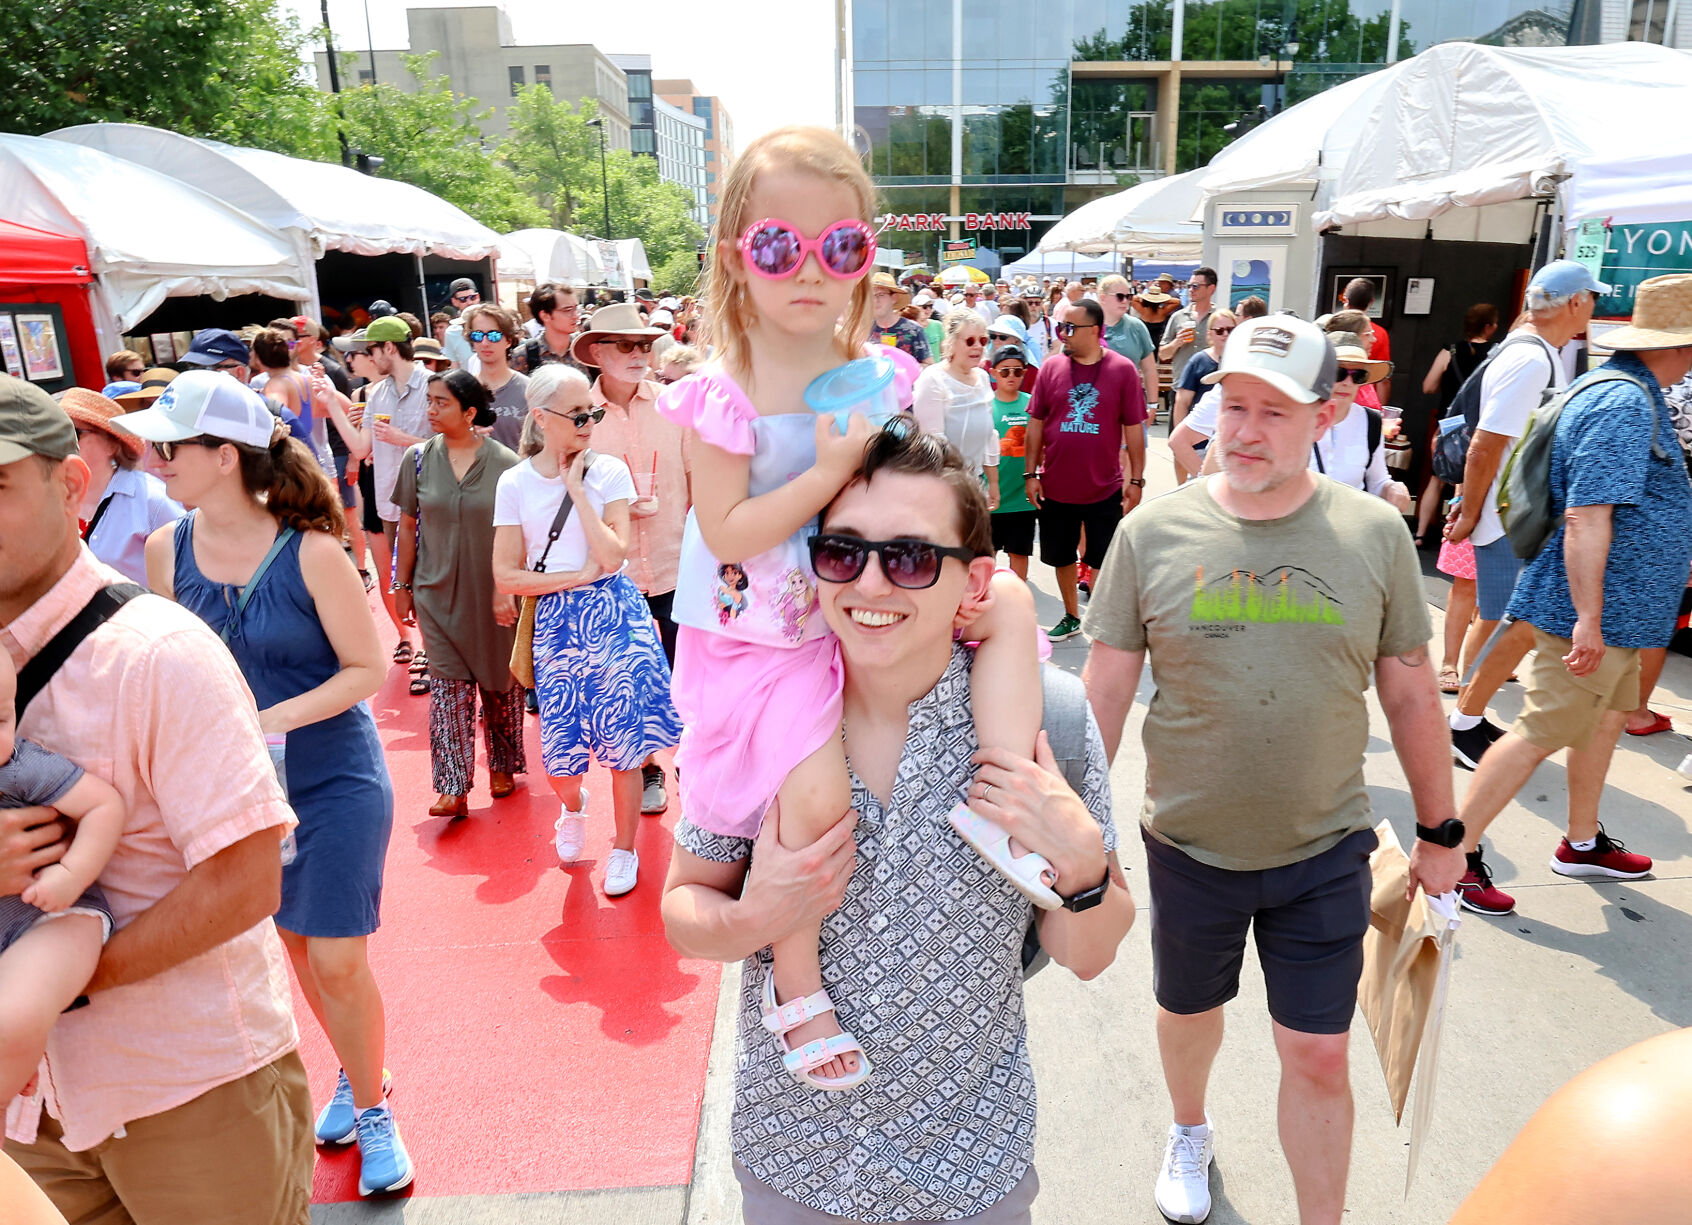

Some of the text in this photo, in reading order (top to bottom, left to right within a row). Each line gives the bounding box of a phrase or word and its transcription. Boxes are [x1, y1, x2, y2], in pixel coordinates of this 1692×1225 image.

[884, 212, 1031, 231] PARK BANK
[1060, 421, 1100, 434] NATURE
[1189, 624, 1247, 632] VANCOUVER
